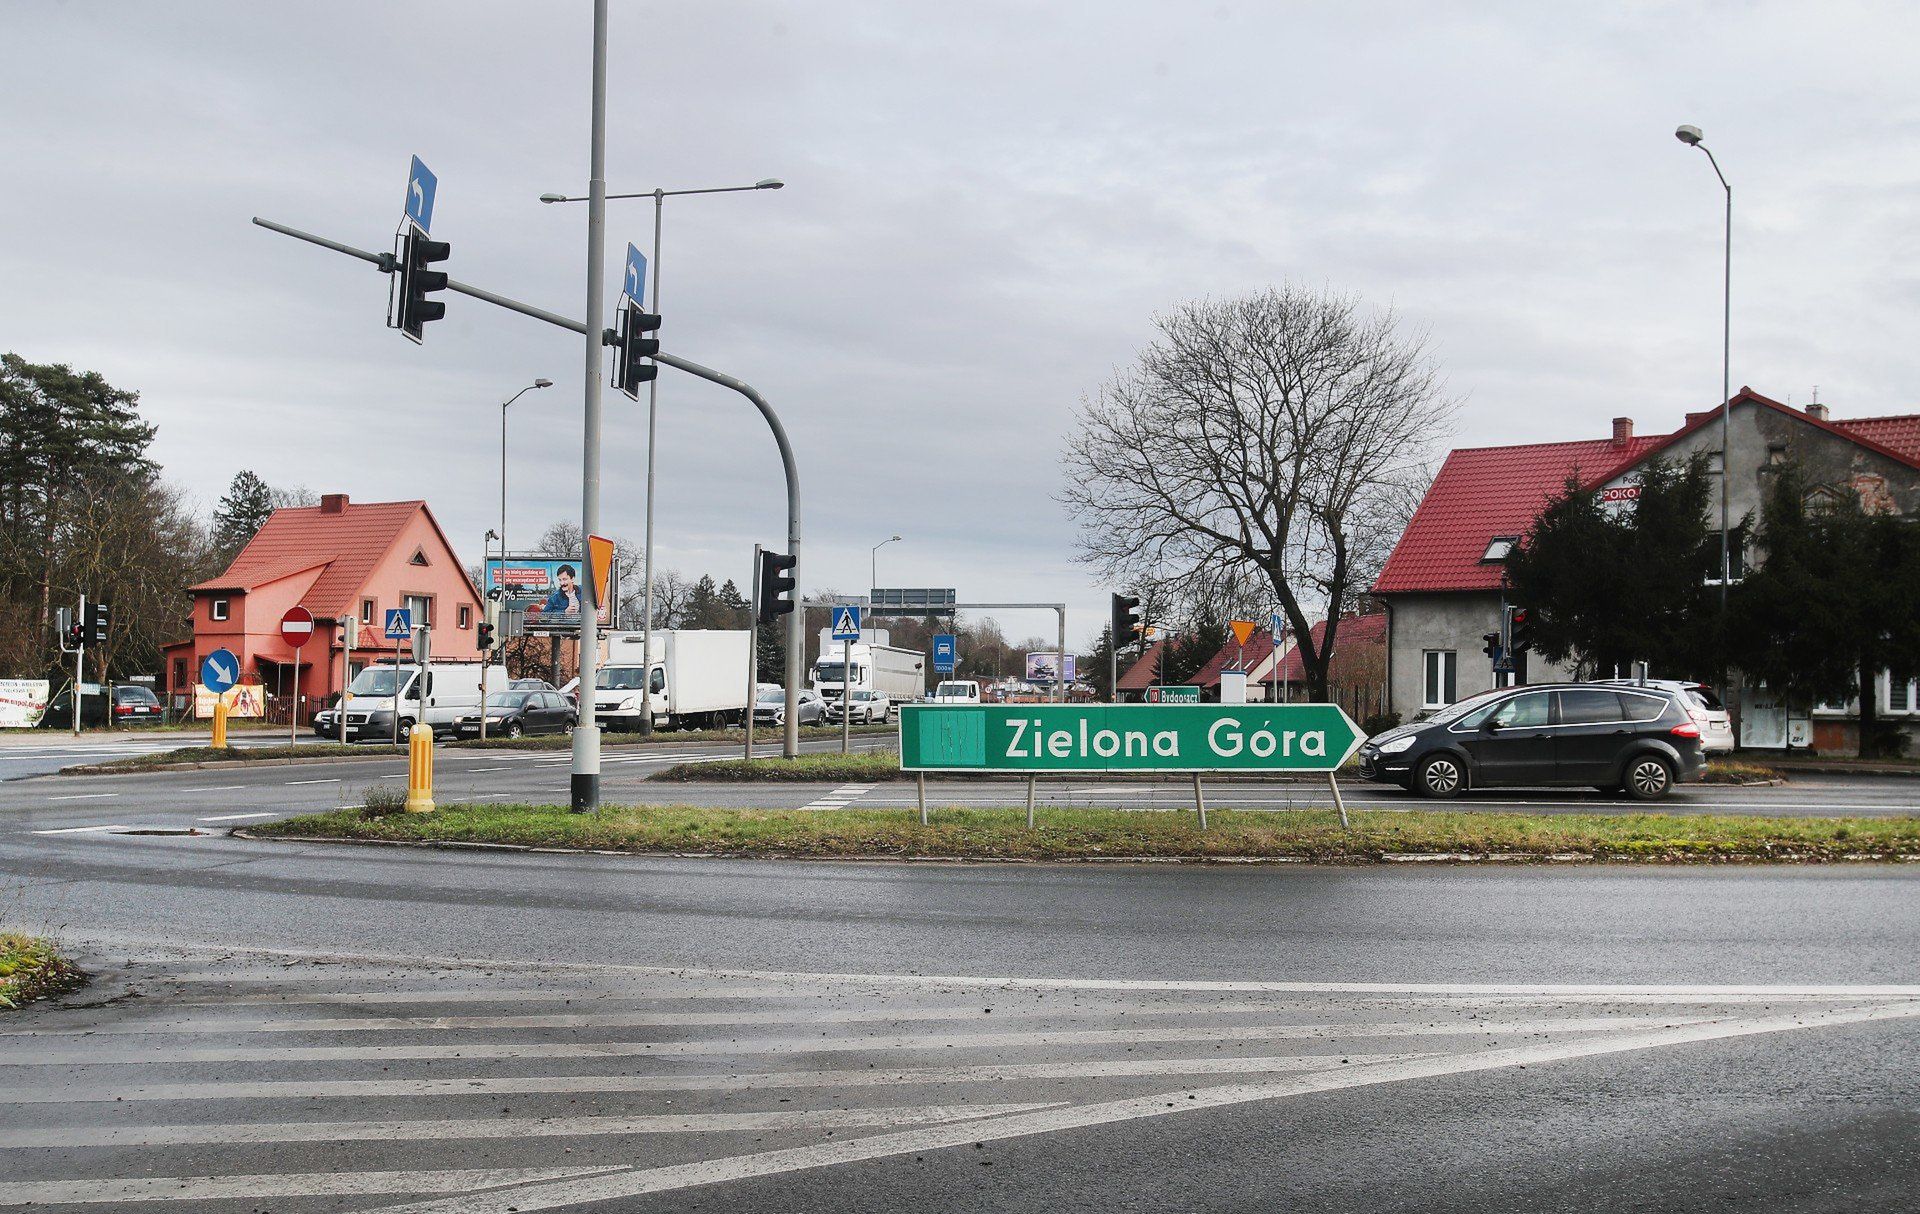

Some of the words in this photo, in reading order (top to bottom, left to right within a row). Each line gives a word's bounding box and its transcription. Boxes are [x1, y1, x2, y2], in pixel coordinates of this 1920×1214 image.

[1603, 488, 1642, 499] POKO
[1151, 691, 1158, 702] 10
[1161, 690, 1198, 703] Bydgoszcz
[1005, 719, 1180, 758] Zielona
[1207, 717, 1328, 758] Góra
